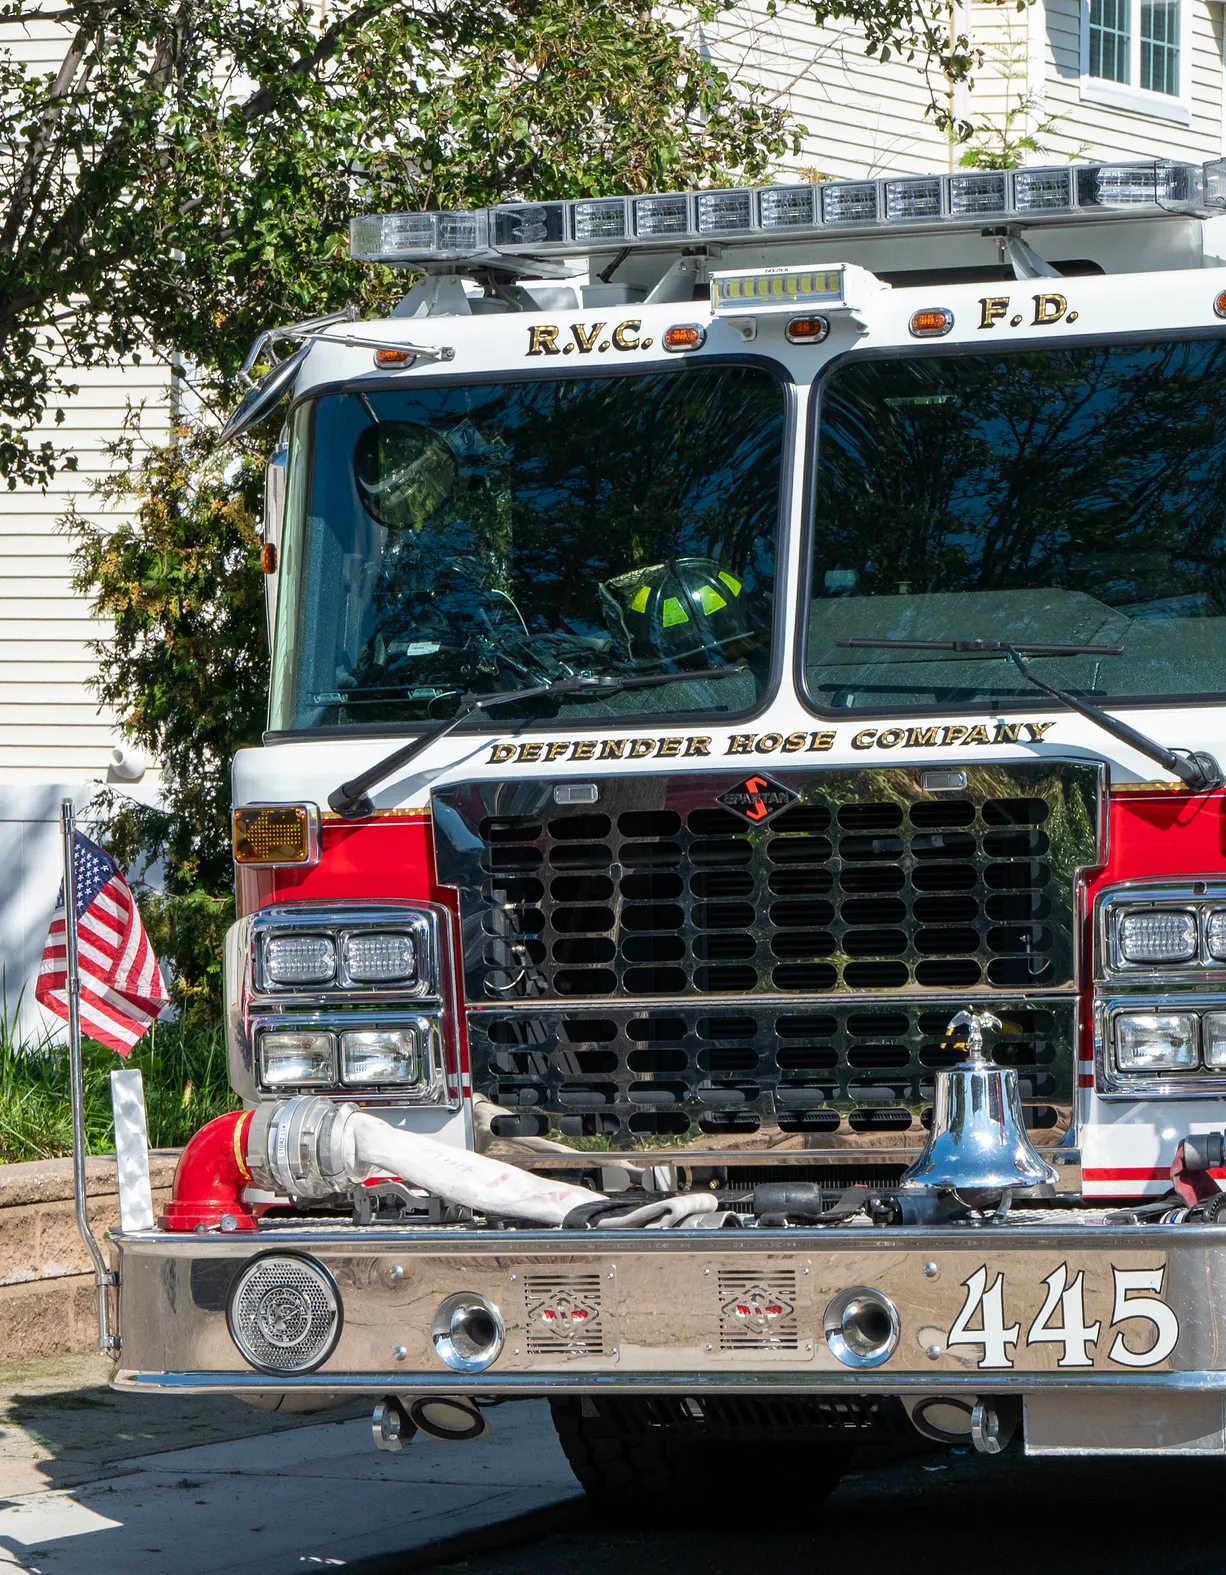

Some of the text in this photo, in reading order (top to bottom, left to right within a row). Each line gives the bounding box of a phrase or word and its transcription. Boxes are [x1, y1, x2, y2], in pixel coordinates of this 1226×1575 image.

[977, 292, 1079, 329] F.D.
[525, 319, 654, 357] R.V.C.
[485, 722, 1056, 765] DEFENDER HOSE COMPANY
[724, 792, 789, 805] SPARTAN
[946, 1260, 1180, 1369] 445
